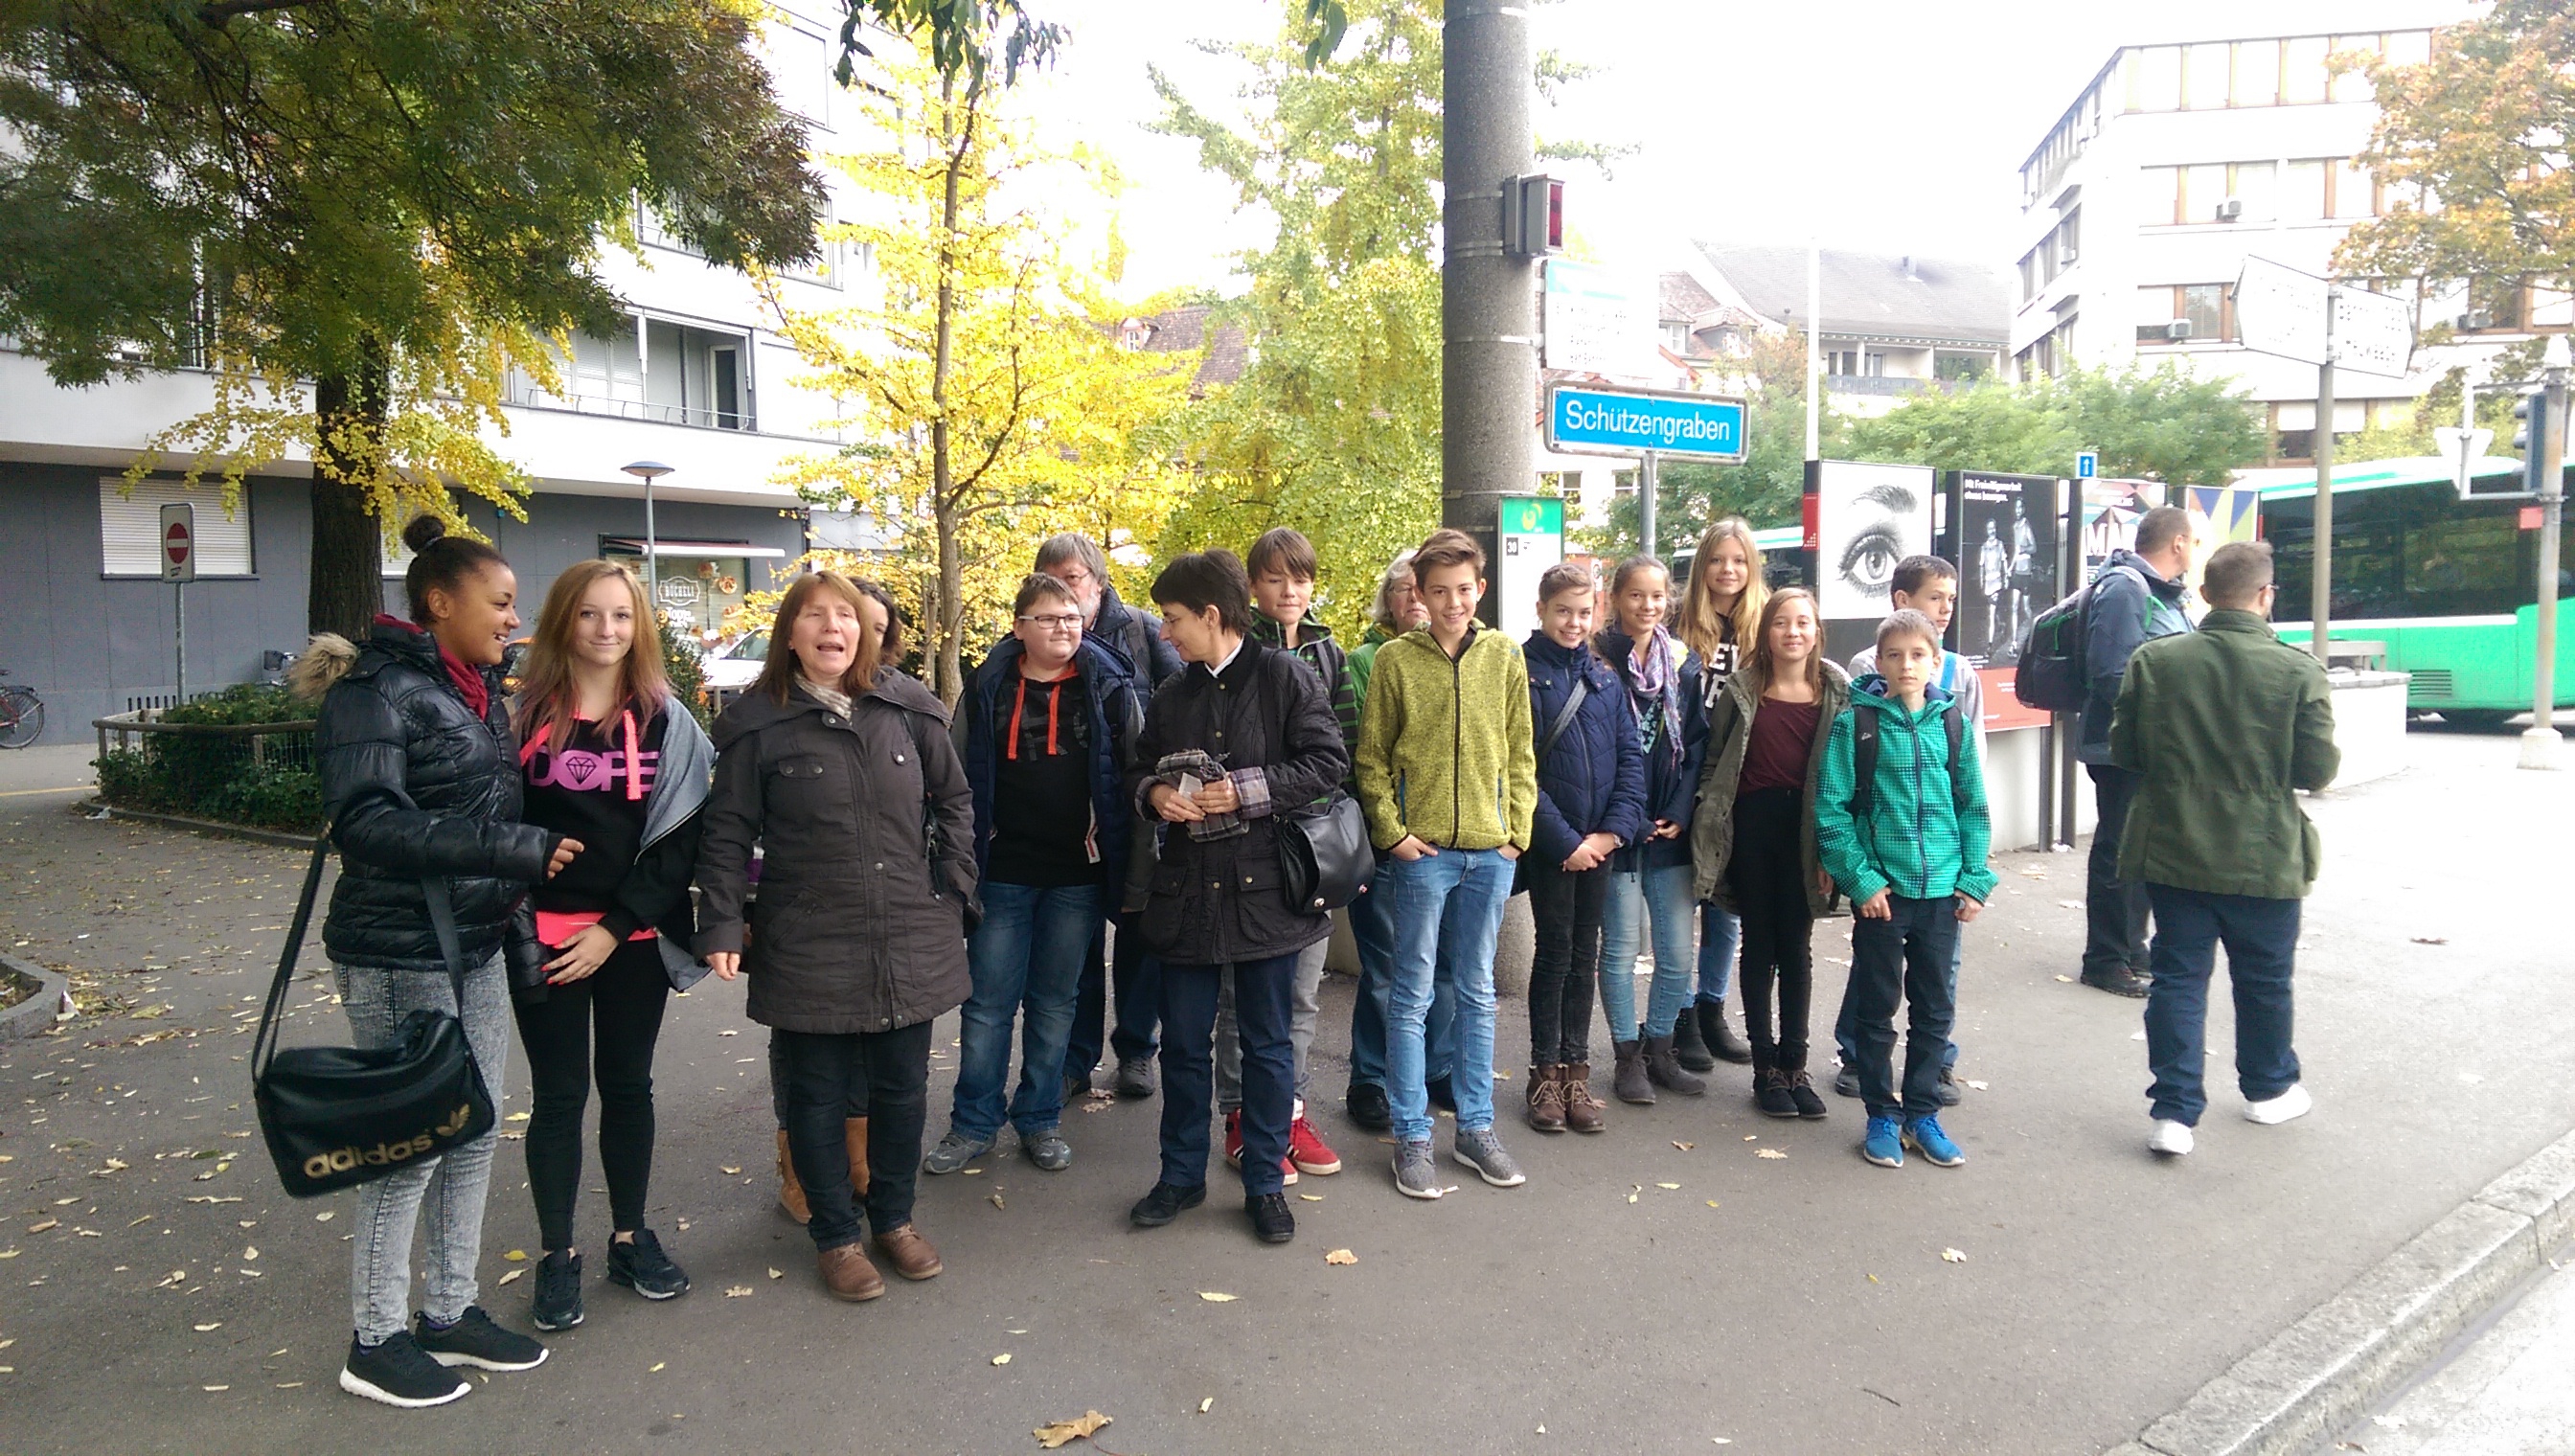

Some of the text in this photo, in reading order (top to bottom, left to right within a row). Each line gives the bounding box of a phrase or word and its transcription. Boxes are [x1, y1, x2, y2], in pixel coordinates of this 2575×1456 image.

[1566, 399, 1730, 444] Schützengraben
[1507, 542, 1517, 553] 30
[528, 745, 660, 792] DOPE
[303, 1133, 434, 1180] adidas
